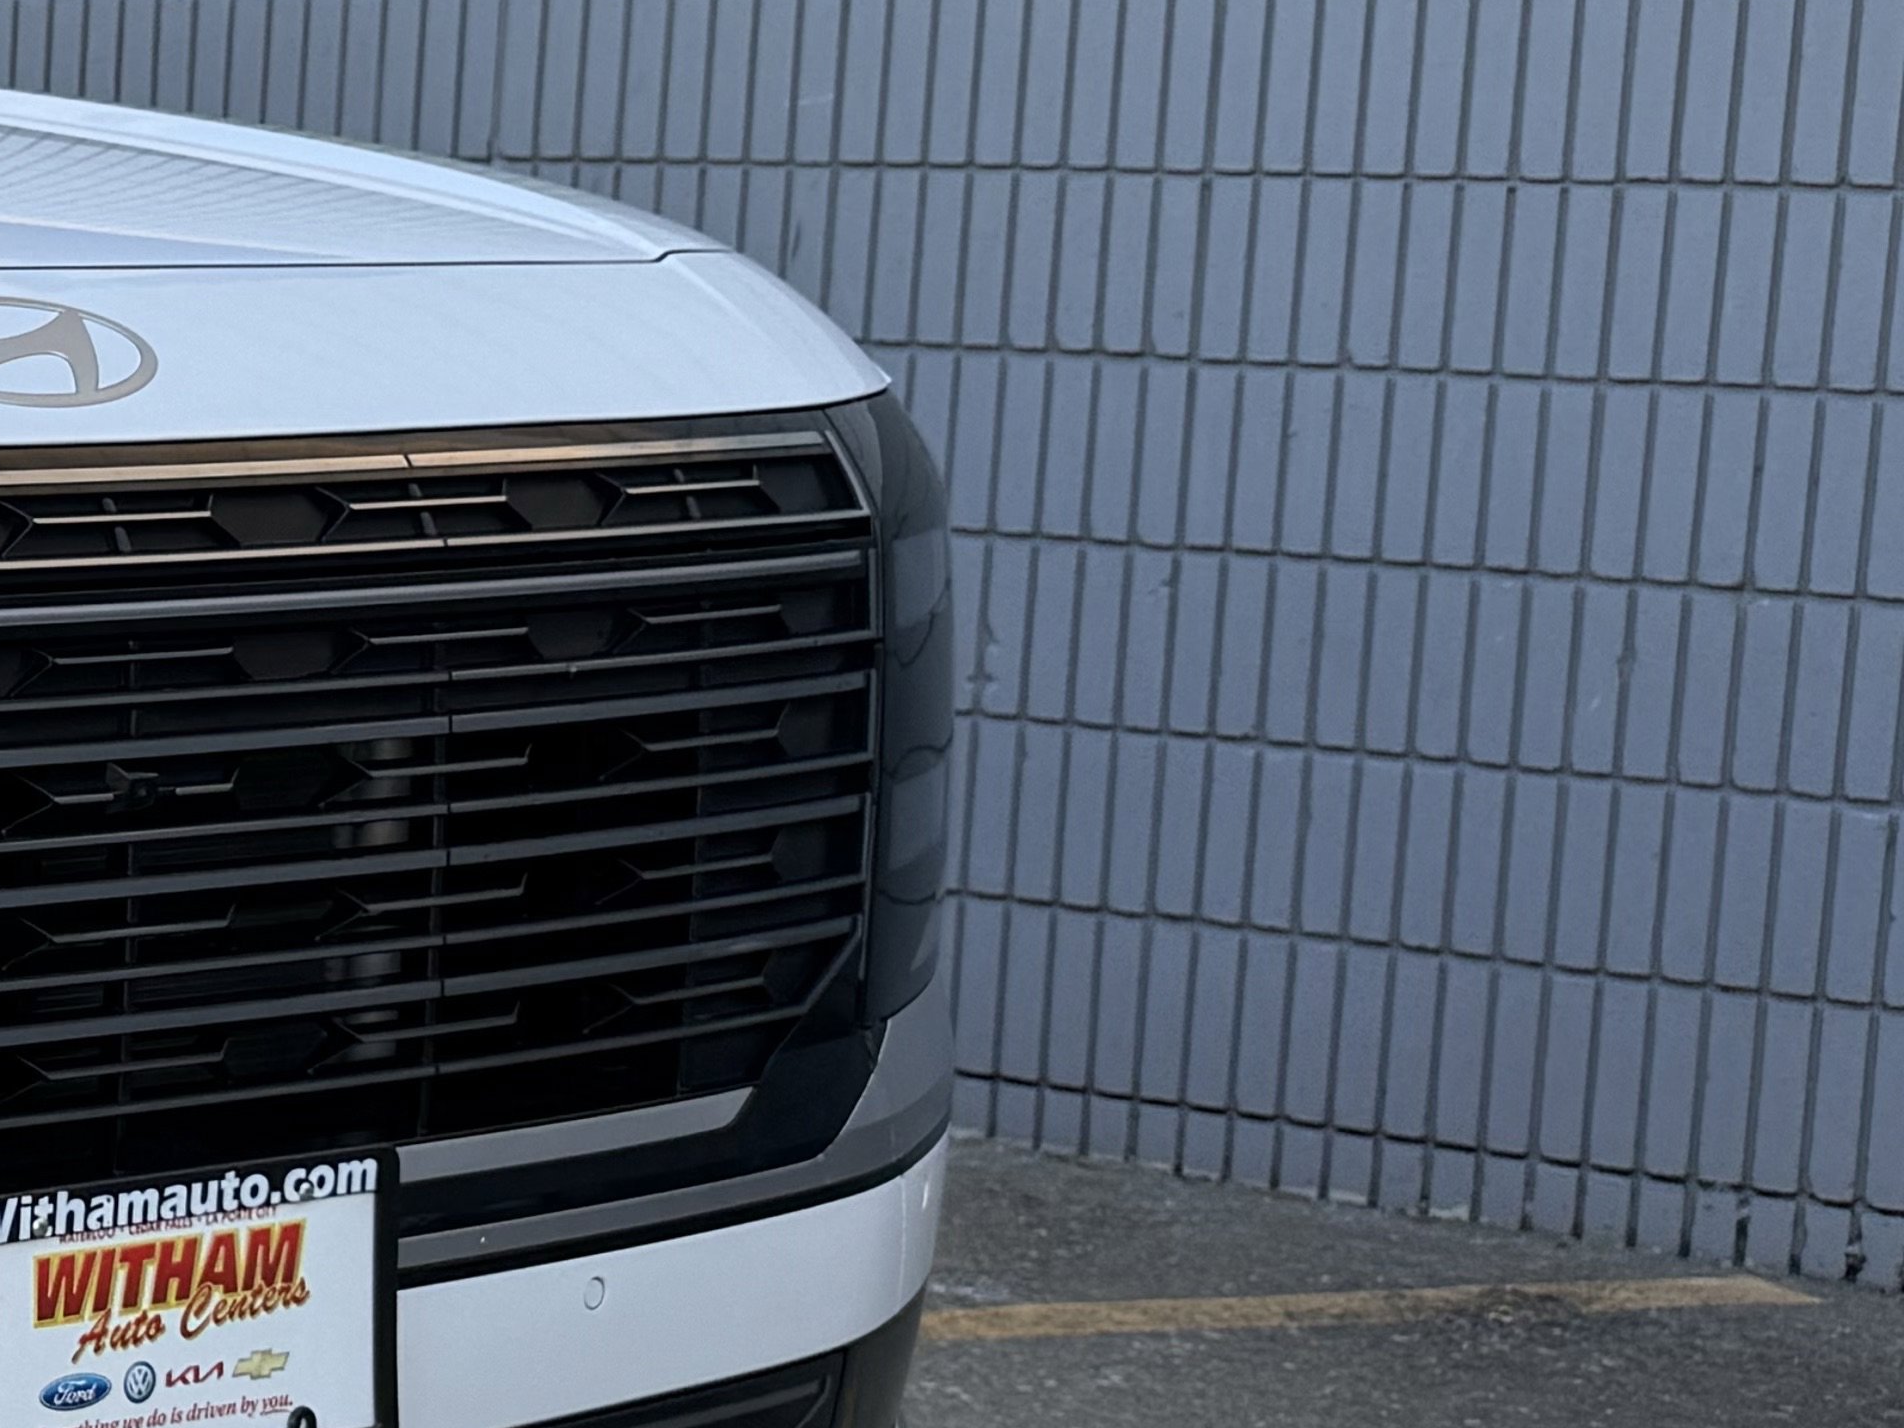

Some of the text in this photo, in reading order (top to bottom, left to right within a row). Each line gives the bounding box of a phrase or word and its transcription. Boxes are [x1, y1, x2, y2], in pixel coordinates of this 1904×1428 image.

[33, 1218, 307, 1329] WITHAM
[71, 1275, 311, 1365] Auto Centers
[50, 1376, 100, 1407] Ford
[146, 1408, 167, 1428] do
[170, 1406, 183, 1424] is
[185, 1401, 237, 1422] driven
[241, 1395, 258, 1417] by
[261, 1393, 294, 1415] you.
